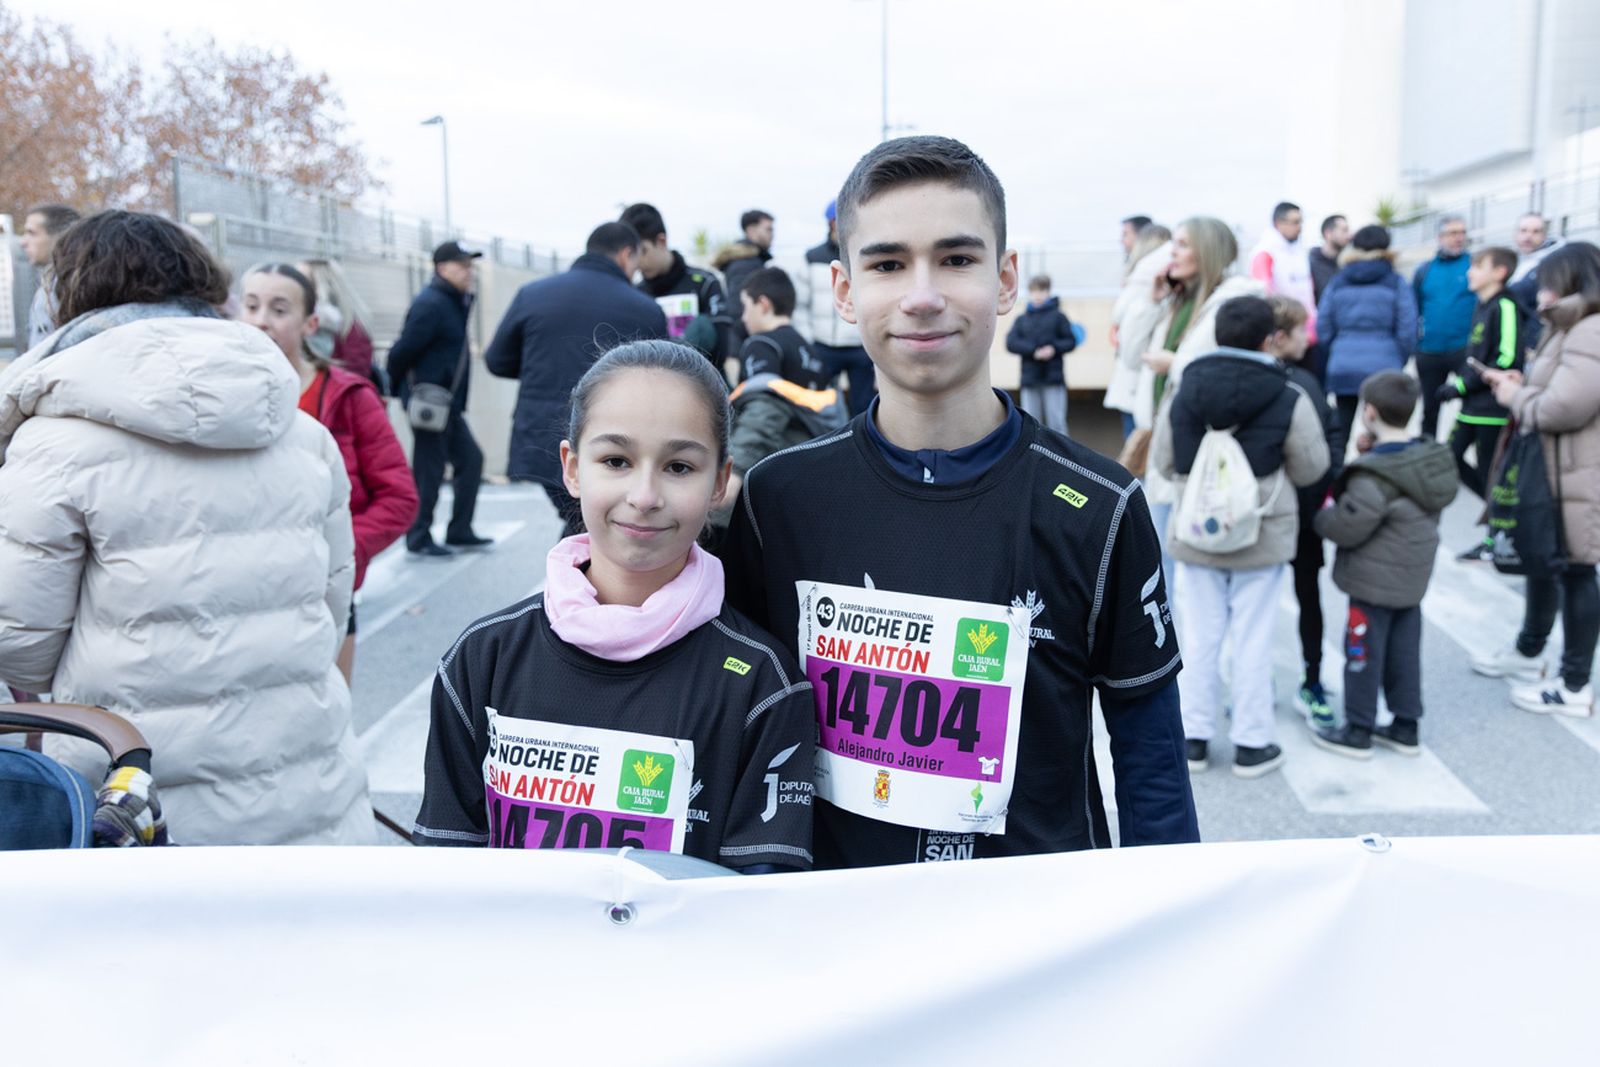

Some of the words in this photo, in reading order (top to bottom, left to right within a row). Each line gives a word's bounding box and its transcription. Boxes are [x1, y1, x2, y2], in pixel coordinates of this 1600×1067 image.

[817, 602, 834, 621] 43
[840, 602, 864, 611] CARRERA
[865, 606, 887, 616] URBANA
[888, 609, 934, 622] INTERNACIONAL
[837, 612, 902, 639] NOCHE
[905, 621, 934, 644] DE
[1030, 627, 1055, 639] URAL
[816, 634, 852, 662] SAN
[854, 642, 930, 673] ANTÓN
[957, 653, 975, 663] CAJA
[976, 656, 1001, 667] RURAL
[820, 666, 981, 753] 14704
[499, 733, 524, 743] CARRERA
[525, 737, 550, 748] URBANA
[551, 740, 600, 754] INTERNACIONAL
[499, 742, 567, 772] NOCHE
[569, 752, 600, 776] DE
[837, 738, 894, 764] Alejandro
[898, 750, 945, 771] Javier
[489, 763, 511, 795] SAN
[513, 774, 595, 806] ANTÓN
[622, 785, 641, 795] CAJA
[641, 788, 665, 799] RURAL
[779, 781, 813, 792] DIPUTA
[794, 794, 812, 806] JAÉ
[492, 798, 646, 848] 14705
[926, 835, 961, 844] NOCHE
[962, 834, 975, 844] DE
[925, 843, 974, 863] SAN
